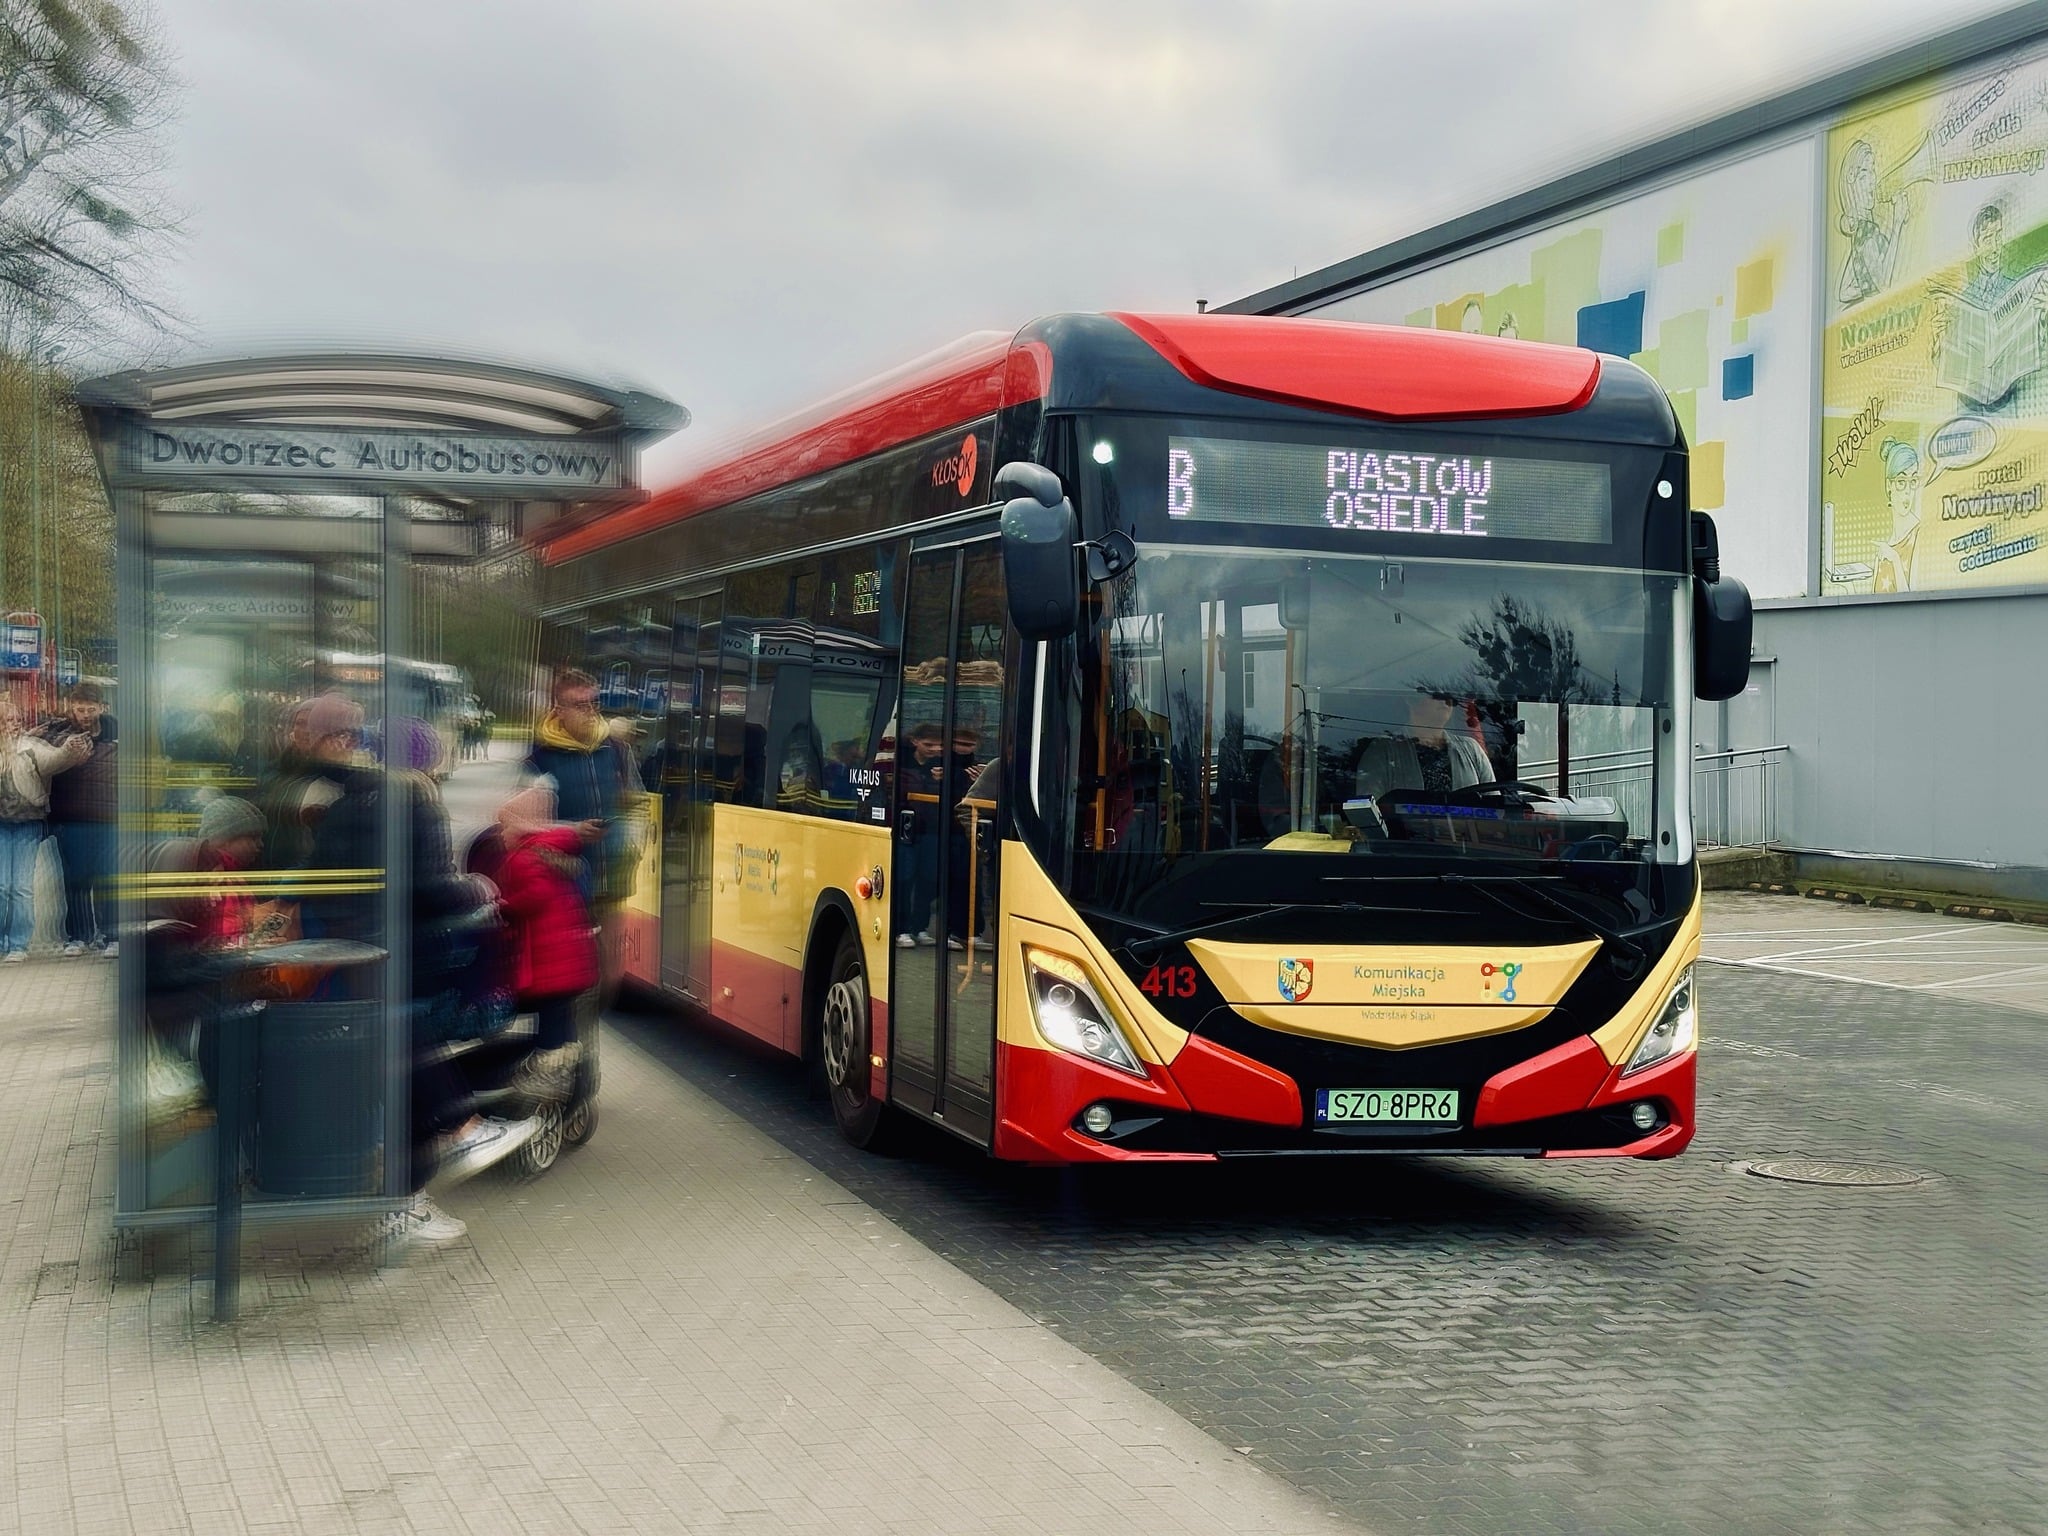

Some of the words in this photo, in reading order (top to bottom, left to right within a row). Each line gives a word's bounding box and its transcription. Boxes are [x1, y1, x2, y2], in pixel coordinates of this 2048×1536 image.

[1943, 150, 2046, 184] INFORMACJI
[1841, 304, 1922, 352] Nowiny
[152, 432, 337, 469] Dworzec
[357, 440, 611, 484] Autobusowy
[931, 450, 974, 488] KŁOSOK
[1978, 460, 2022, 489] portal
[1326, 491, 1488, 536] OSIEDLE
[1942, 483, 2043, 520] Nowiny.pl
[1949, 523, 1992, 553] czytaj
[1959, 536, 2038, 572] codziennie
[20, 654, 29, 667] 3
[849, 768, 880, 786] IKARUS
[1140, 966, 1197, 998] 413
[1354, 965, 1445, 983] Komunikacja
[1372, 984, 1425, 1000] Miejska
[1318, 1109, 1327, 1117] PL
[1390, 1093, 1452, 1119] 8PR6
